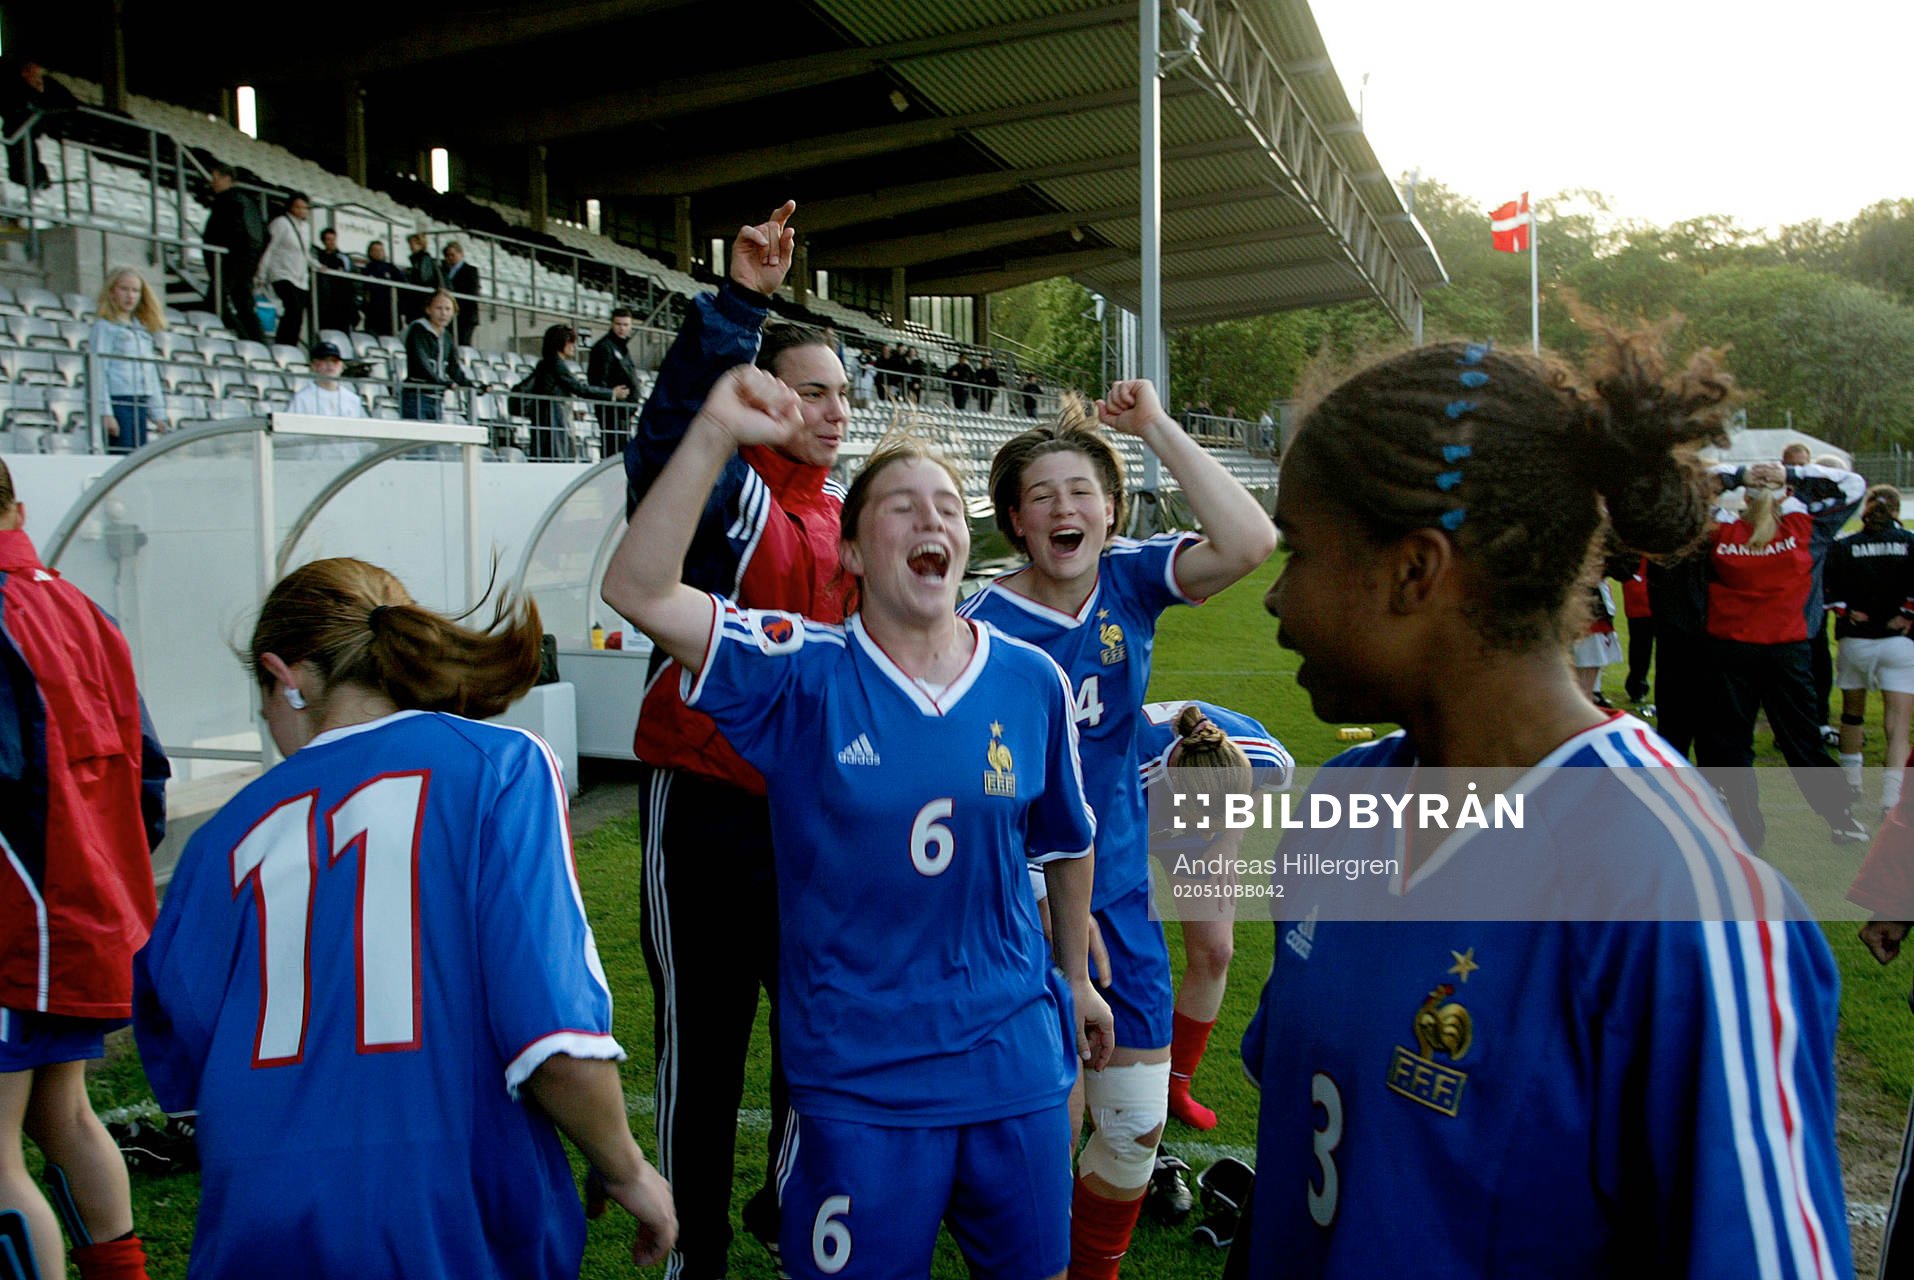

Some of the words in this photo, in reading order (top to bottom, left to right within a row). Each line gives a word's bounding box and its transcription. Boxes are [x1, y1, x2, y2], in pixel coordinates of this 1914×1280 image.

[838, 751, 881, 767] adidas
[909, 796, 955, 878] 6
[229, 769, 431, 1069] 11
[1307, 1072, 1344, 1227] 3
[811, 1193, 852, 1276] 6
